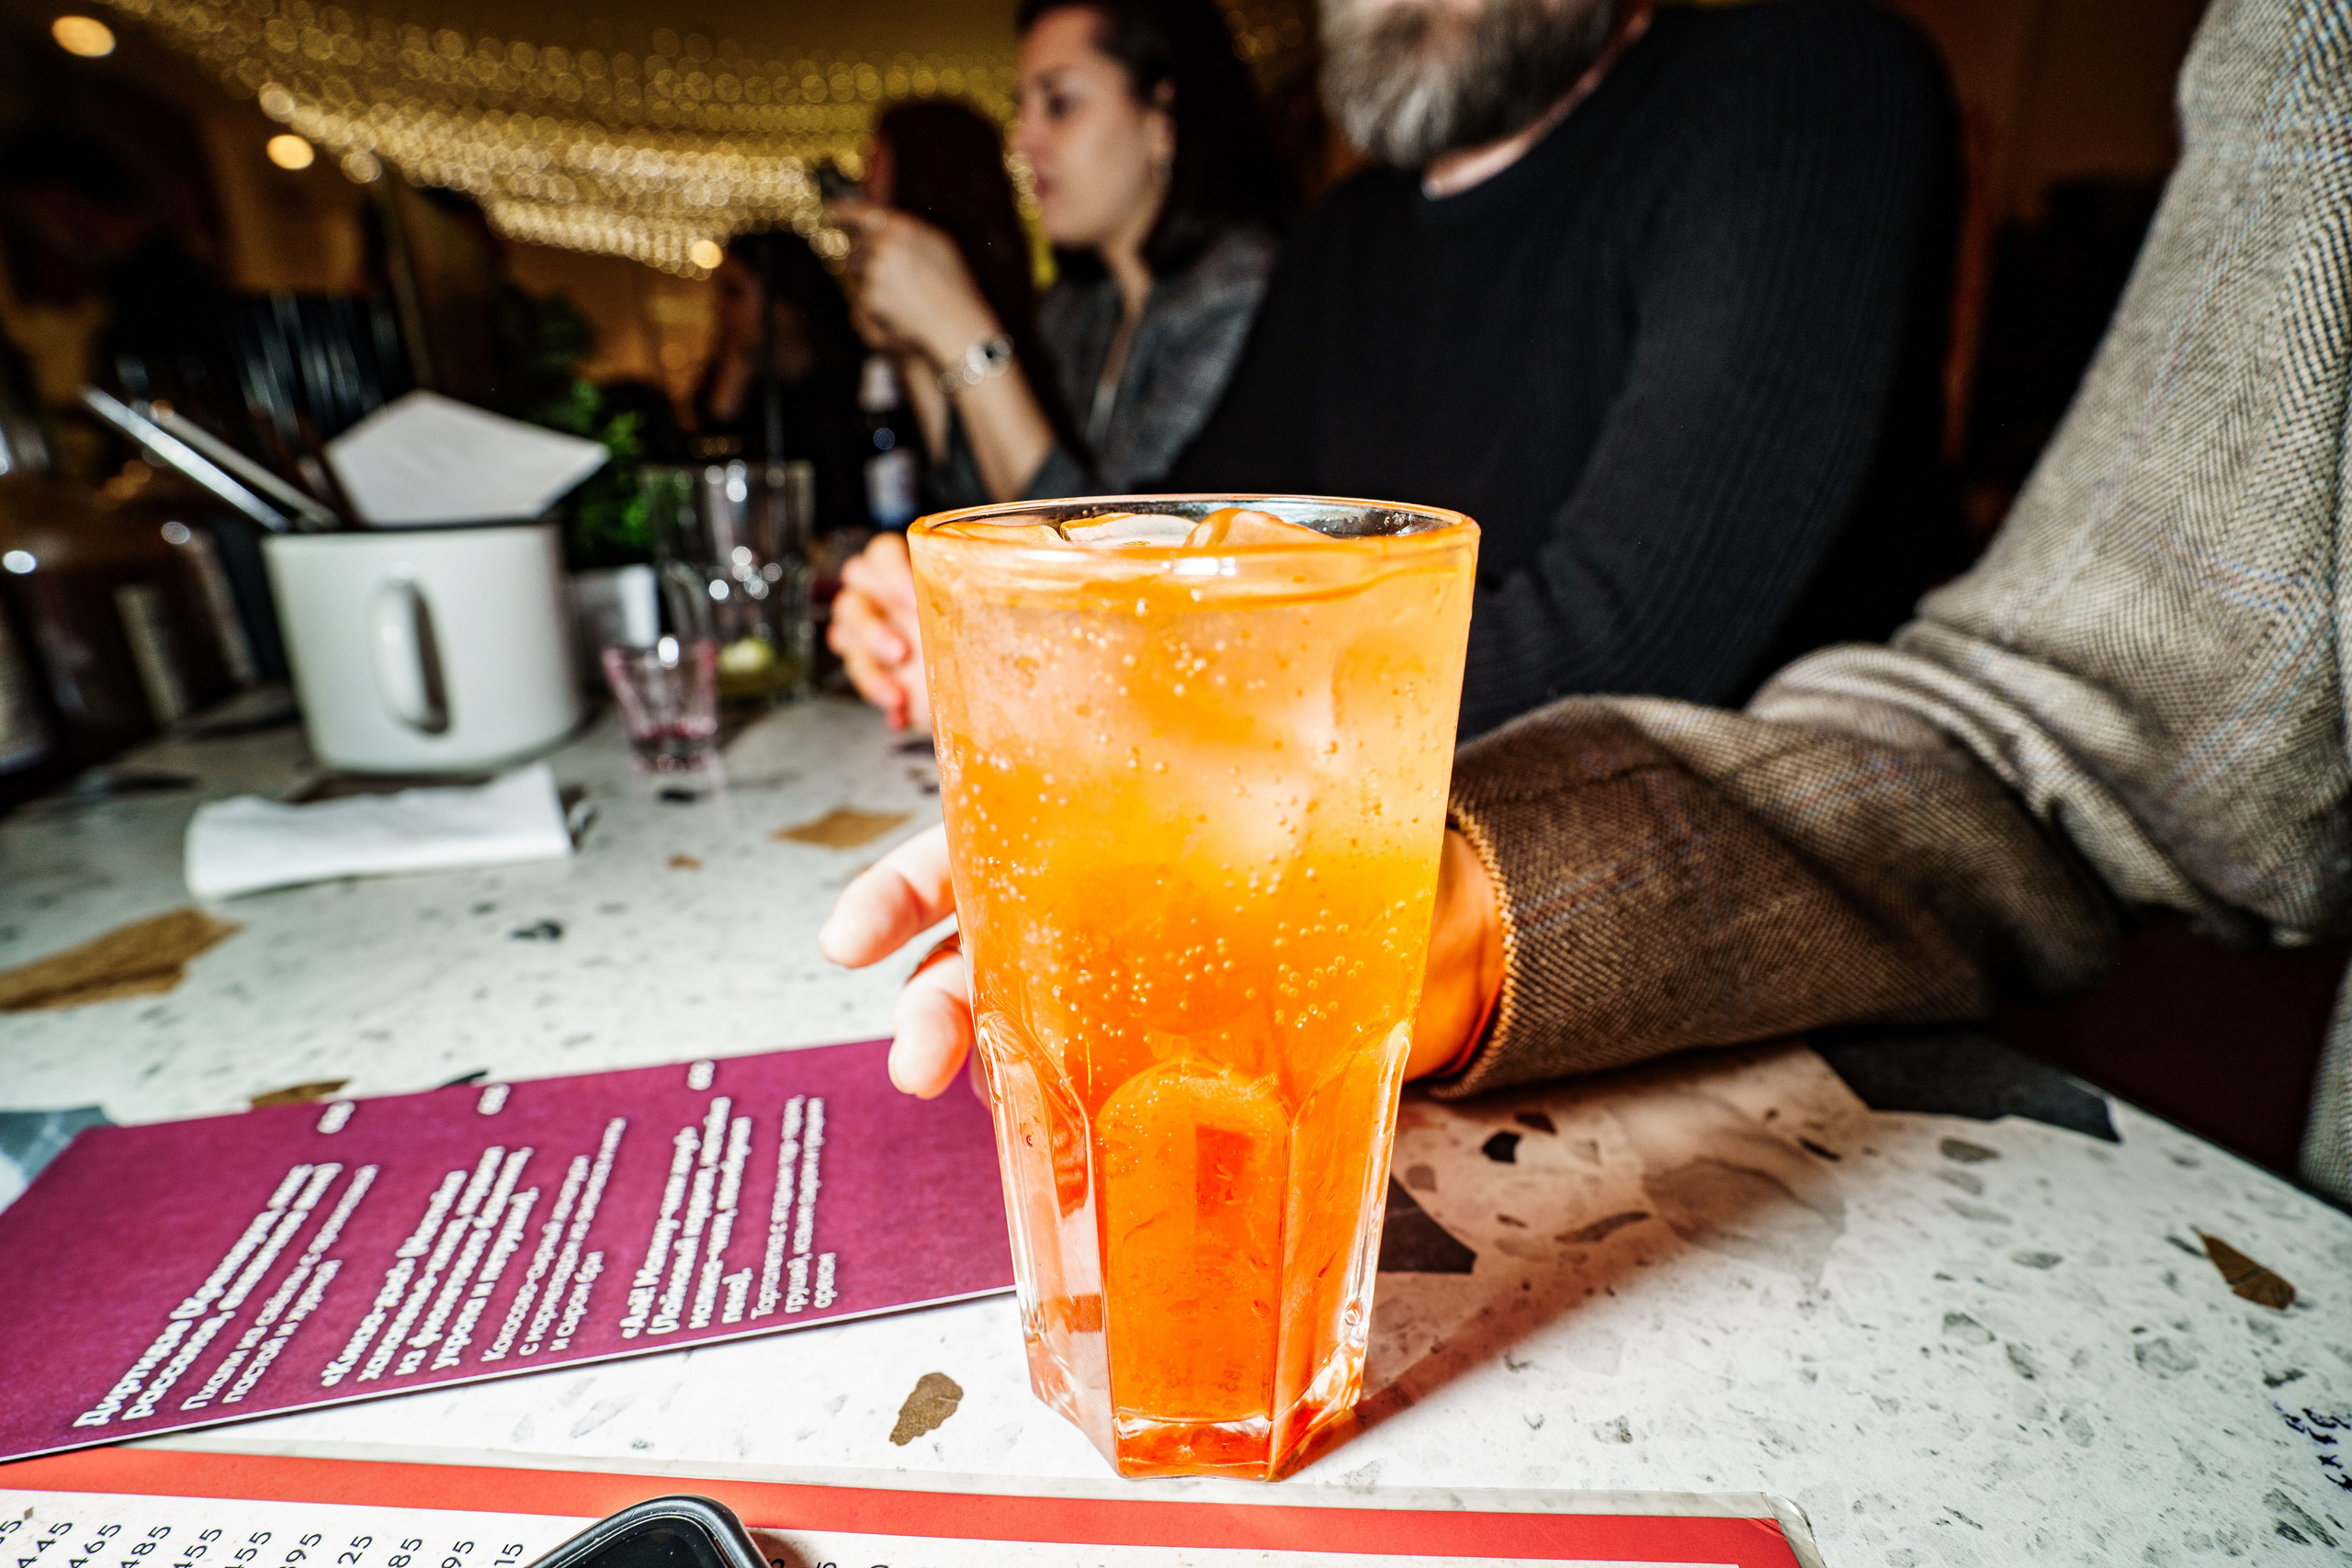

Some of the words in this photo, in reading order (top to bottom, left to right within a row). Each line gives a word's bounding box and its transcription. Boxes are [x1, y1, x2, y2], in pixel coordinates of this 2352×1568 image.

[430, 1298, 487, 1371] укропа
[470, 1282, 494, 1297] и
[556, 1282, 592, 1337] сыром
[121, 1311, 235, 1420] рассолов,
[180, 1350, 249, 1410] Пхали
[236, 1325, 267, 1349] из
[222, 1337, 288, 1404] пастой
[275, 1323, 298, 1337] и
[394, 1349, 426, 1375] из
[519, 1343, 539, 1356] с
[549, 1337, 570, 1351] и
[73, 1320, 192, 1427] Диртидзе
[17, 1522, 73, 1568] 445
[224, 1531, 272, 1568] 55
[278, 1533, 322, 1568] 95
